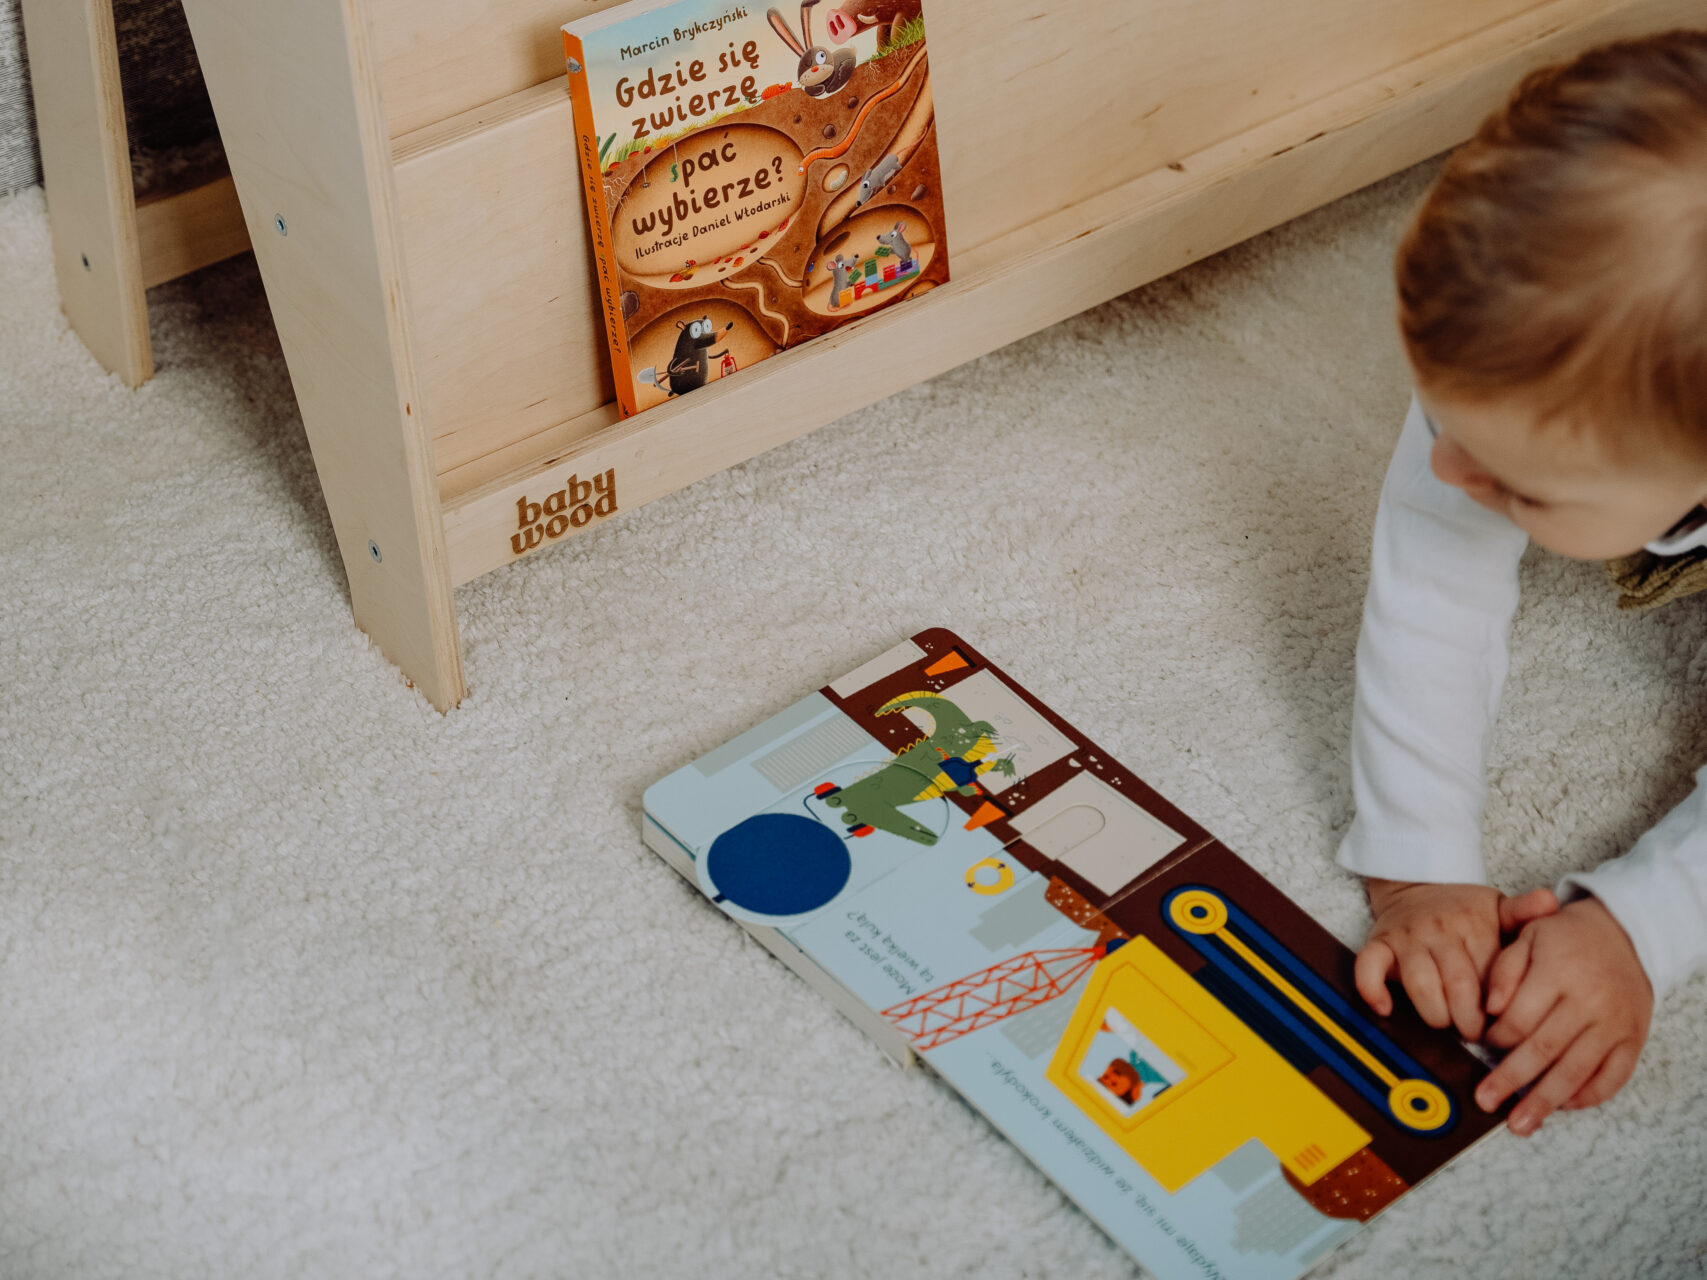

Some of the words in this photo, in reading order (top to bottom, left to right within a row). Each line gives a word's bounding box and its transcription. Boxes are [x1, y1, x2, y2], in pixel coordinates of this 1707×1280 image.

[620, 36, 670, 61] Marcin
[673, 5, 748, 42] Brykczyński
[615, 59, 707, 108] Gdzie
[718, 40, 760, 73] się
[631, 75, 758, 140] zwierzę
[582, 134, 593, 170] Gdzie
[669, 131, 737, 188] spać
[631, 155, 784, 238] wybierze?
[635, 231, 689, 260] Ilustracje
[692, 215, 732, 238] Daniel
[734, 191, 791, 221] Włodarski
[510, 491, 618, 554] wood
[515, 467, 616, 530] baby
[844, 929, 861, 943] za
[881, 934, 919, 971] wielką
